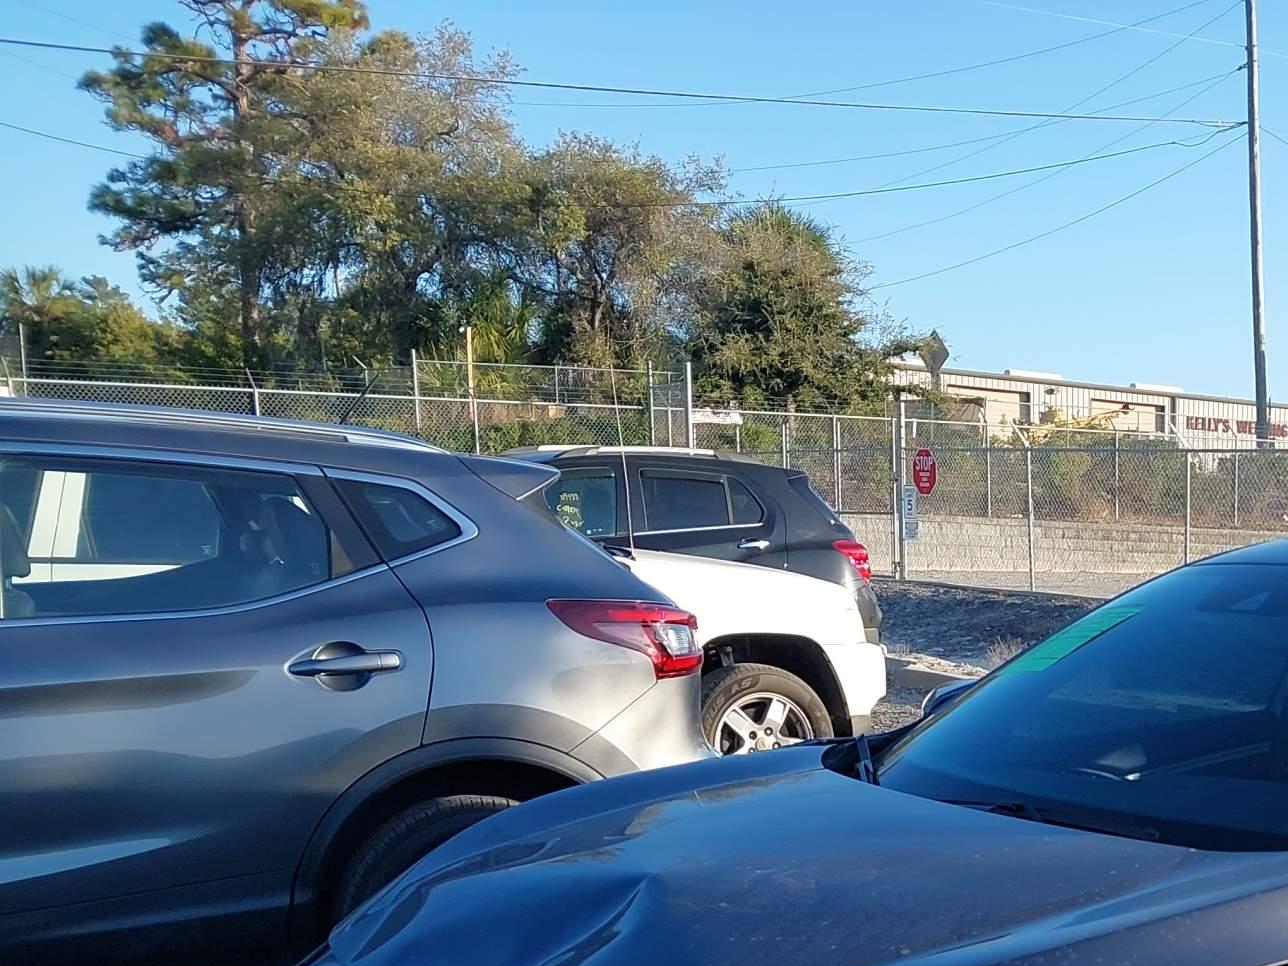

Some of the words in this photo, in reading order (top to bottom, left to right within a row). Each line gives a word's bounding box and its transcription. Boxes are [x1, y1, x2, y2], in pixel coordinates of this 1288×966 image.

[1186, 415, 1230, 433] KELLY'S
[1236, 420, 1288, 438] WEING
[915, 456, 933, 471] STOP
[907, 499, 913, 511] 5
